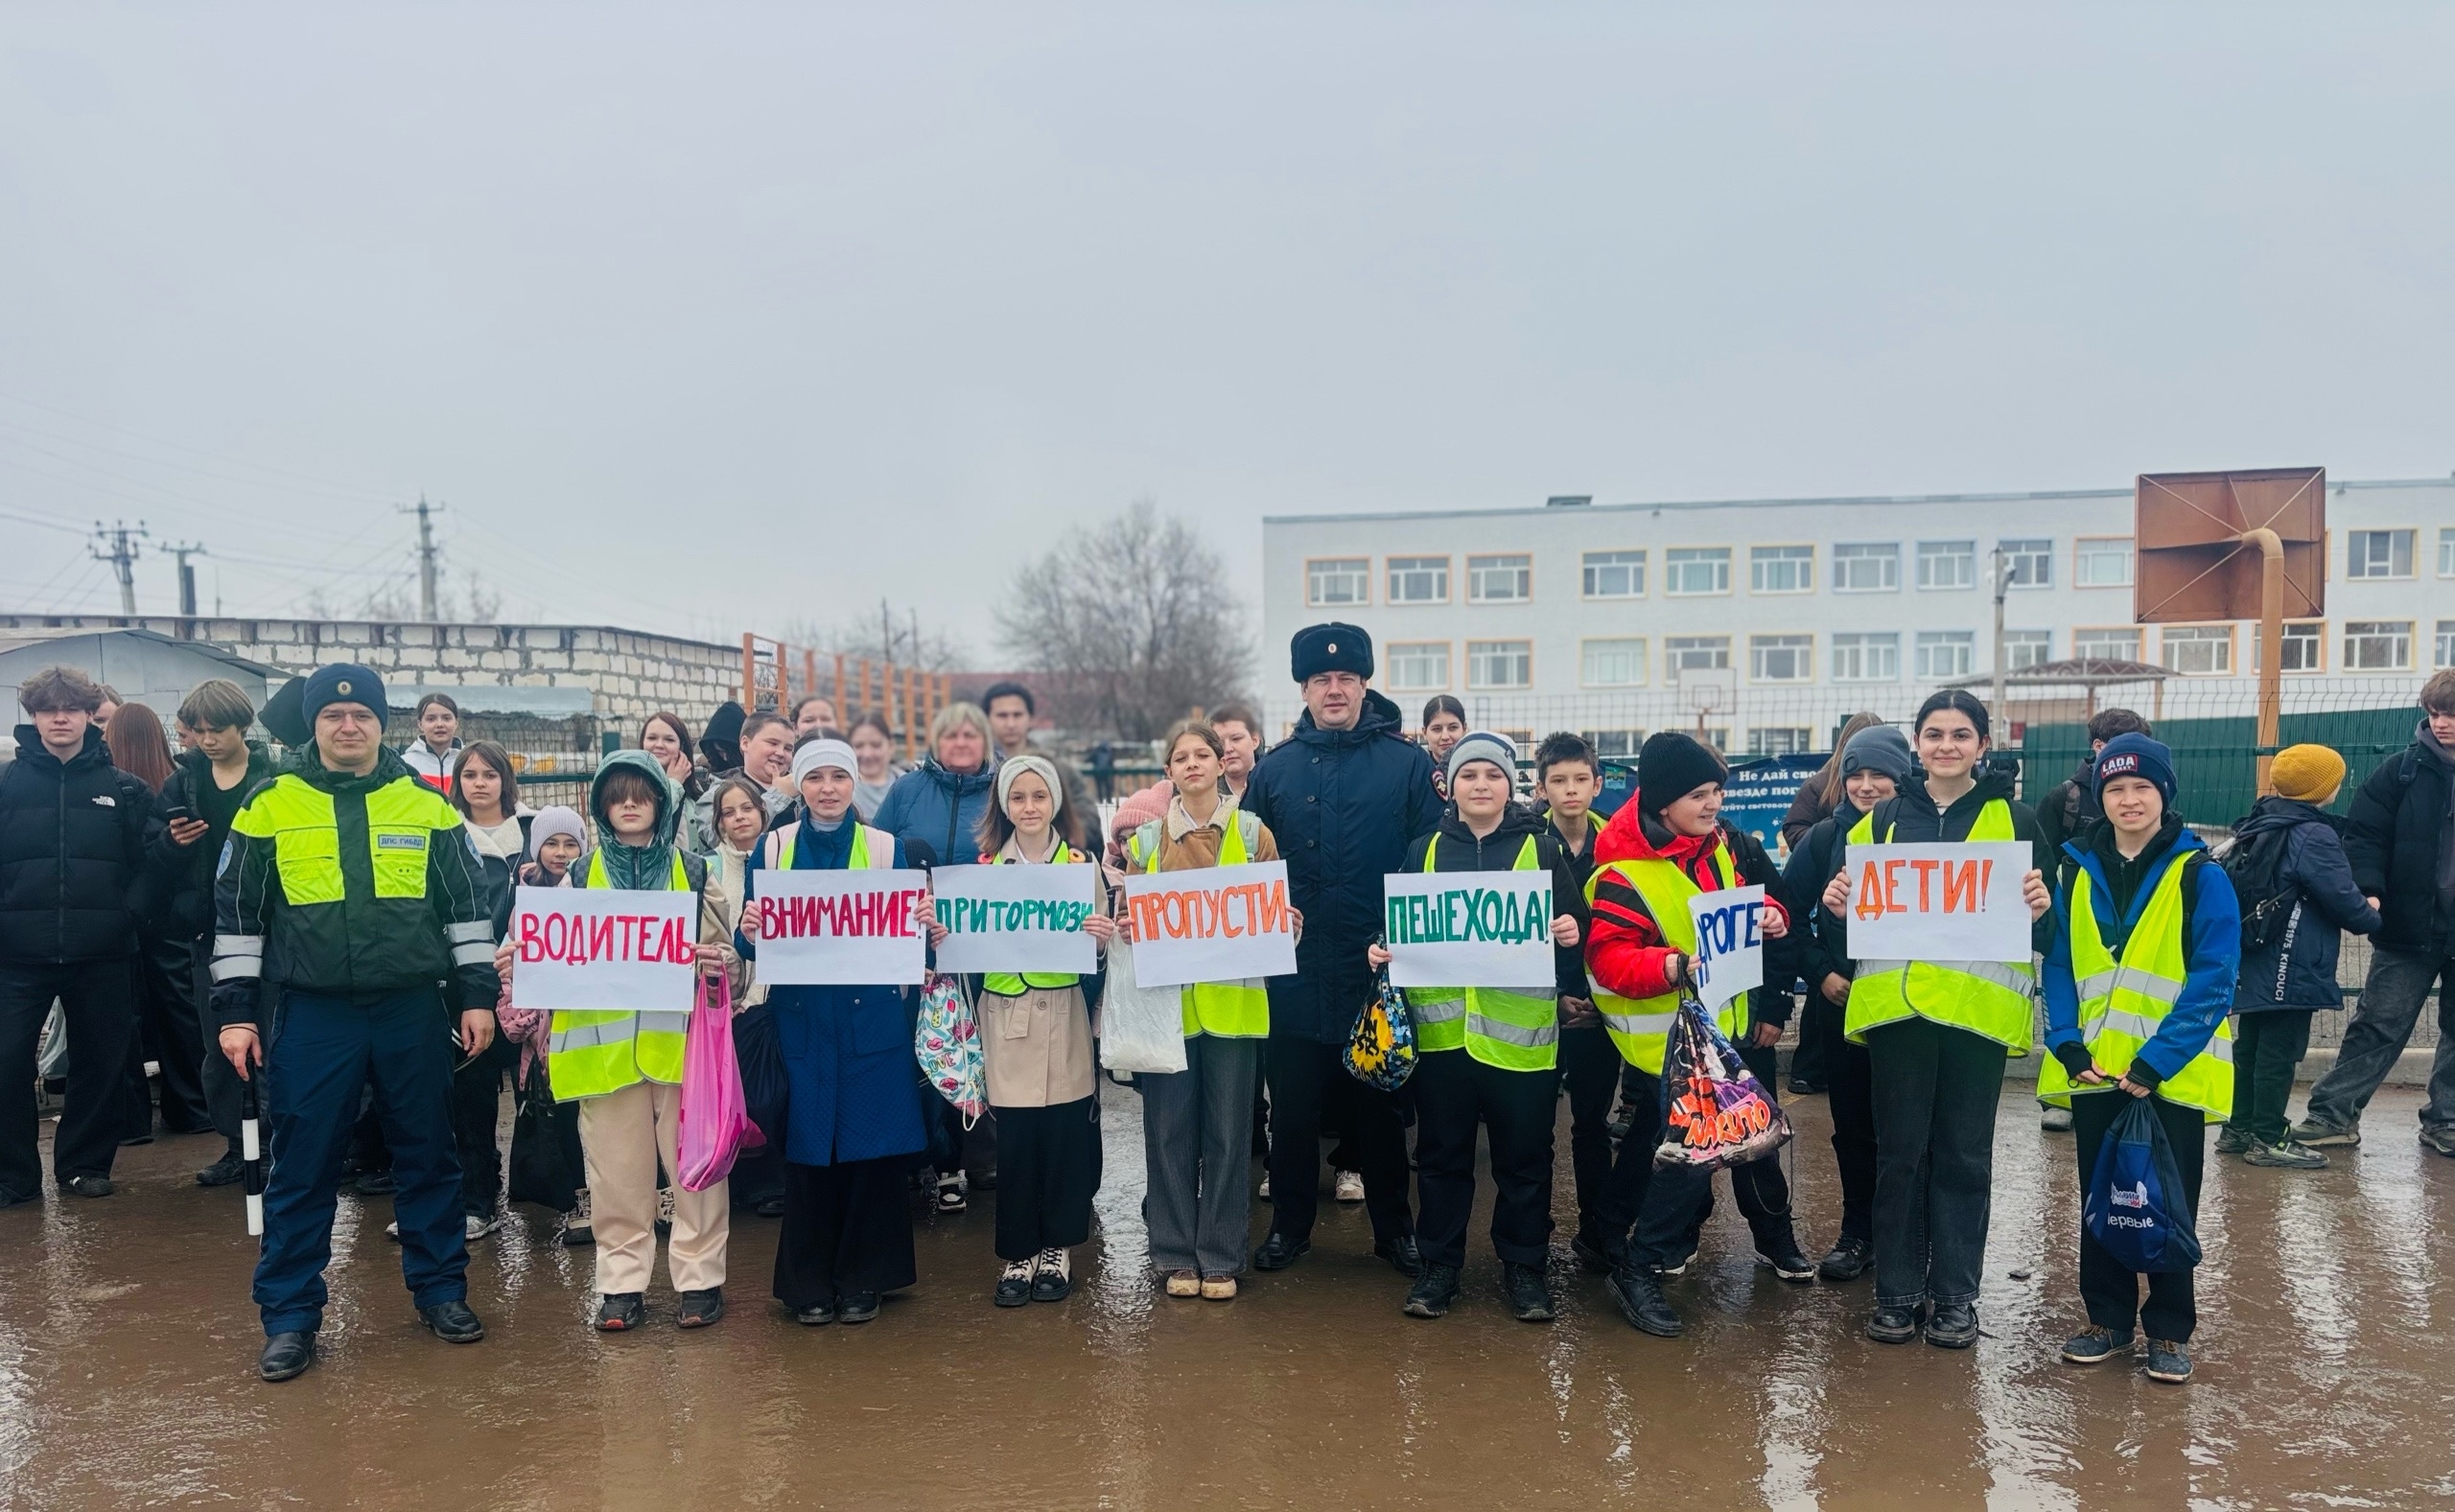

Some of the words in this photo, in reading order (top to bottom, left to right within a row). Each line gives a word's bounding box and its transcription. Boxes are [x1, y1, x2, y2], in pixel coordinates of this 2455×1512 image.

[1739, 770, 1759, 781] Не
[1762, 769, 1789, 781] дай
[2102, 756, 2135, 773] LADA
[1771, 786, 1801, 795] пог
[381, 837, 397, 846] ДПС
[400, 838, 423, 847] ГИБДД
[1855, 859, 1994, 921] ДЕТИ!
[935, 897, 1094, 933] ПРИТОРМОЗИ
[1129, 879, 1289, 942] ПРОПУСТИ
[1388, 888, 1552, 944] ПЕШЕХОДА!
[521, 912, 695, 966] ВОДИТЕЛЬ
[1696, 901, 1764, 962] РОГЕ
[2108, 1212, 2155, 1230] ервые
